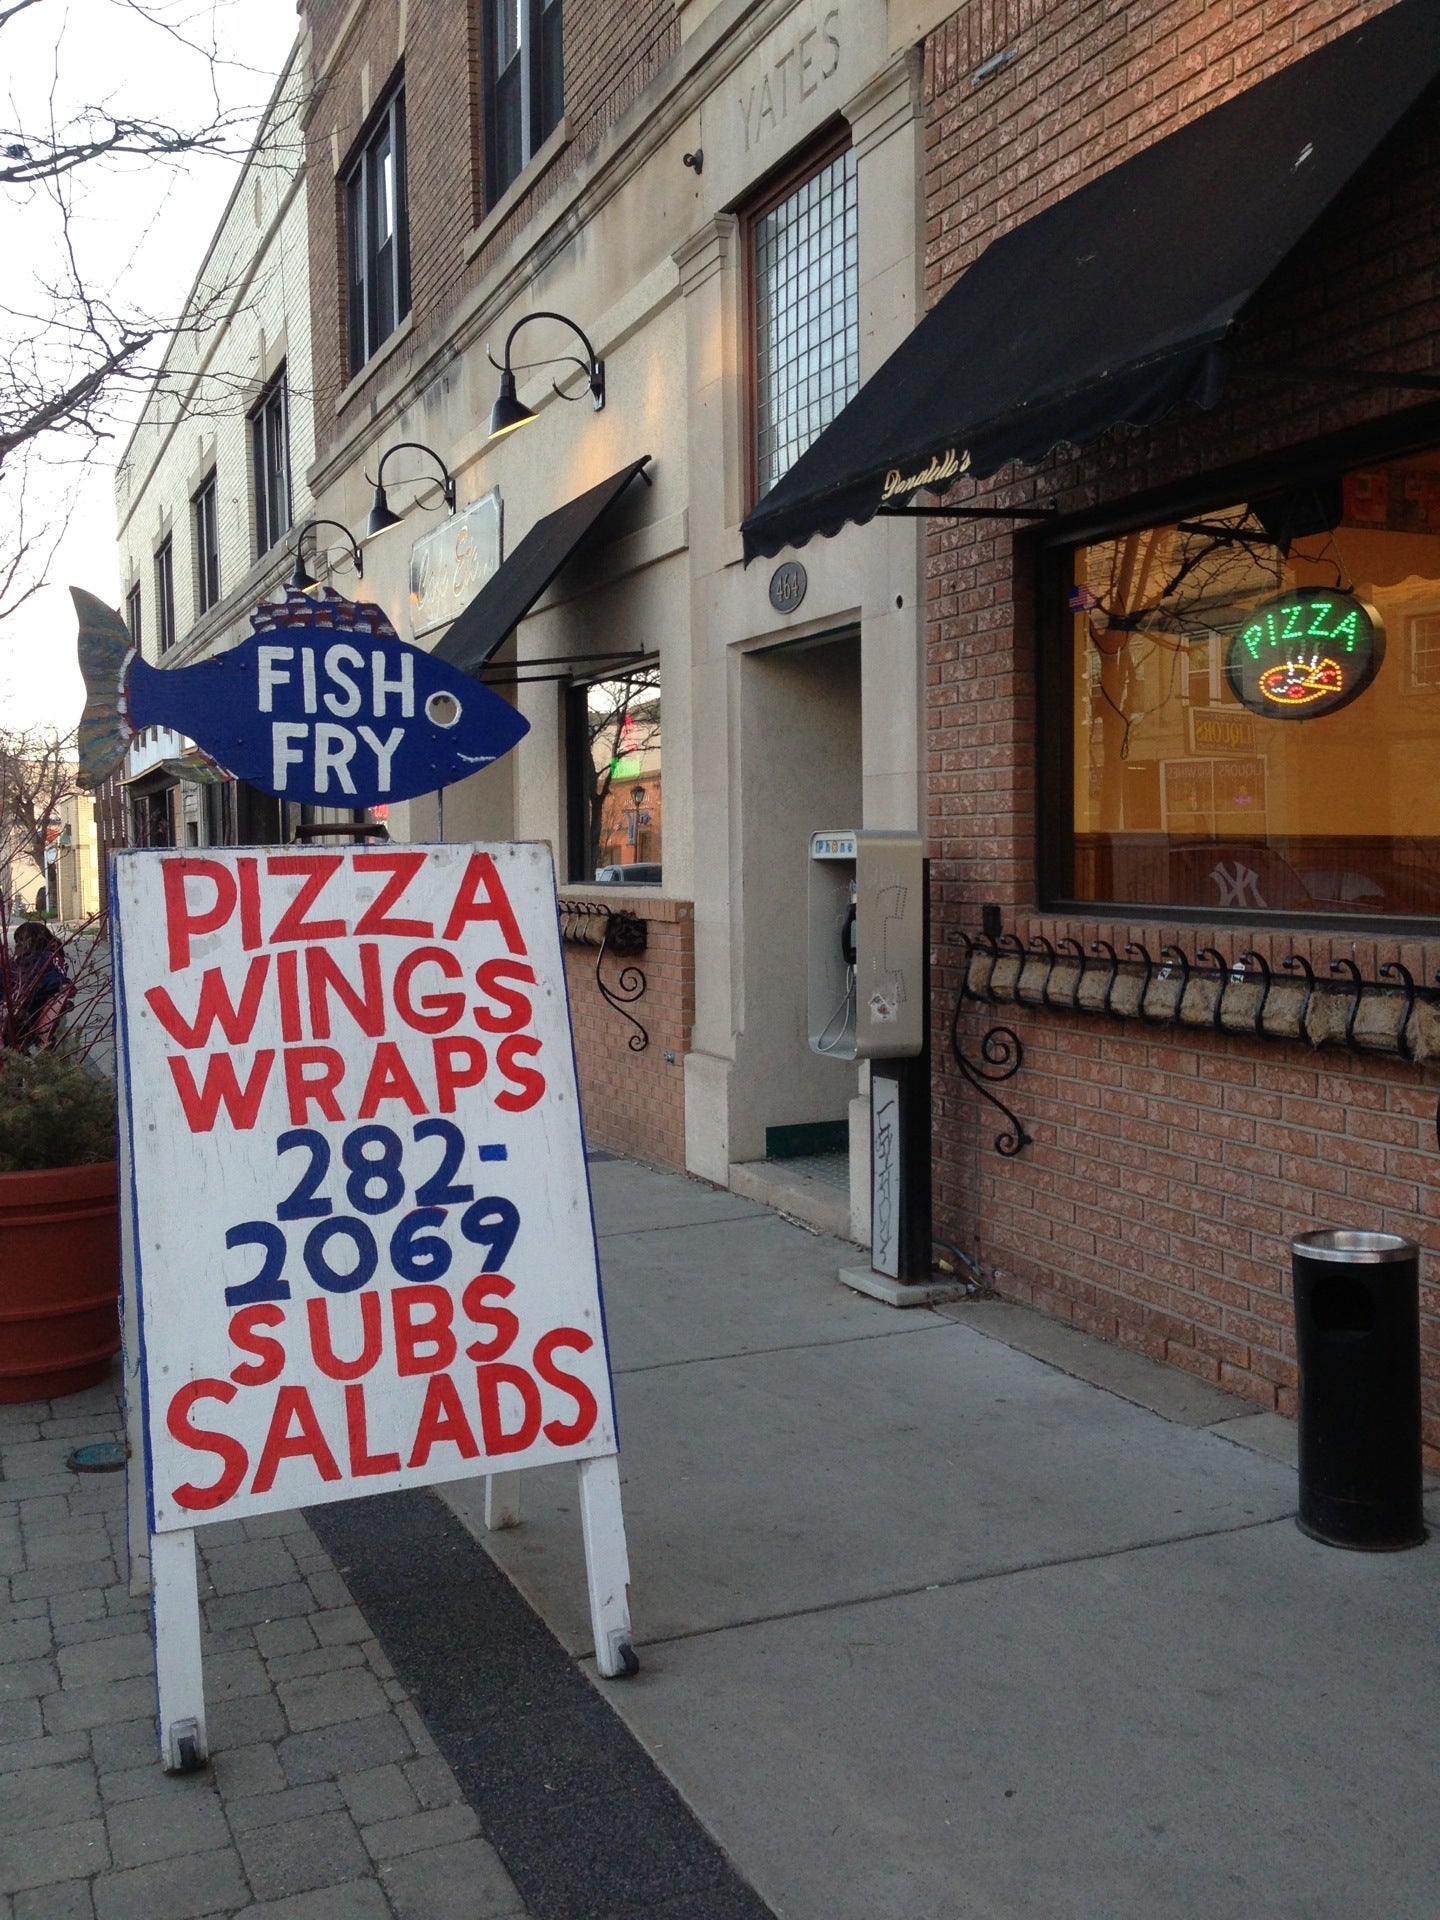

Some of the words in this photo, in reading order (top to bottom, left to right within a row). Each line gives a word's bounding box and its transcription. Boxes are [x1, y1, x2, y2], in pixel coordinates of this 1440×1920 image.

[738, 8, 840, 153] YATES
[881, 448, 971, 500] Donatello's
[776, 571, 800, 603] 464
[1243, 603, 1357, 659] PIZZA
[258, 643, 415, 718] FISH
[272, 721, 405, 795] FRY
[162, 852, 528, 972] PIZZA
[144, 942, 538, 1049] WINGS
[167, 1034, 546, 1133] WRAPS
[276, 1118, 508, 1221] 282-
[224, 1196, 521, 1307] 2069
[228, 1274, 520, 1386] SUBS
[166, 1327, 598, 1510] SALADS
